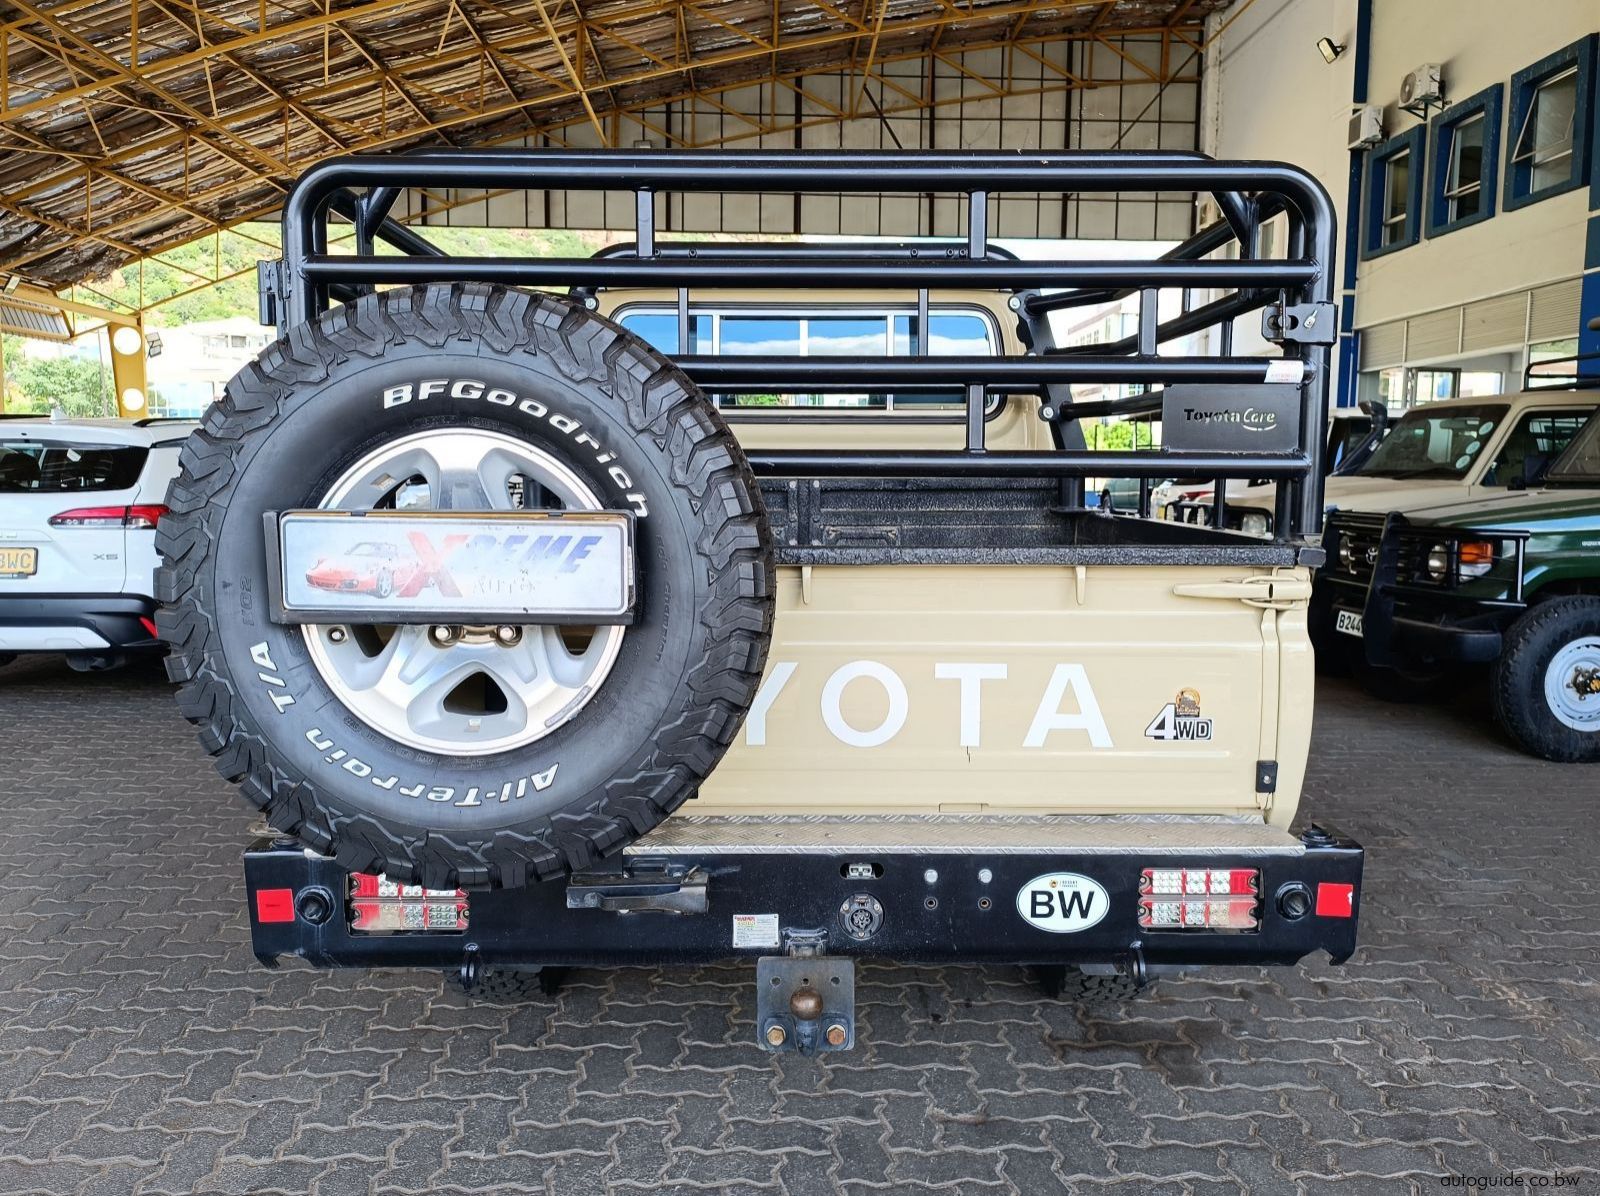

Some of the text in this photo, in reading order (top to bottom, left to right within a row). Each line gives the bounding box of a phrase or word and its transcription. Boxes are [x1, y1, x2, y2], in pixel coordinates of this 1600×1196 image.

[383, 378, 649, 518] BFGoodrich
[250, 641, 297, 714] T/A
[745, 659, 1114, 748] YOTA
[1144, 702, 1212, 740] 4WD
[305, 728, 559, 807] All-Terrain
[1030, 890, 1095, 919] BW
